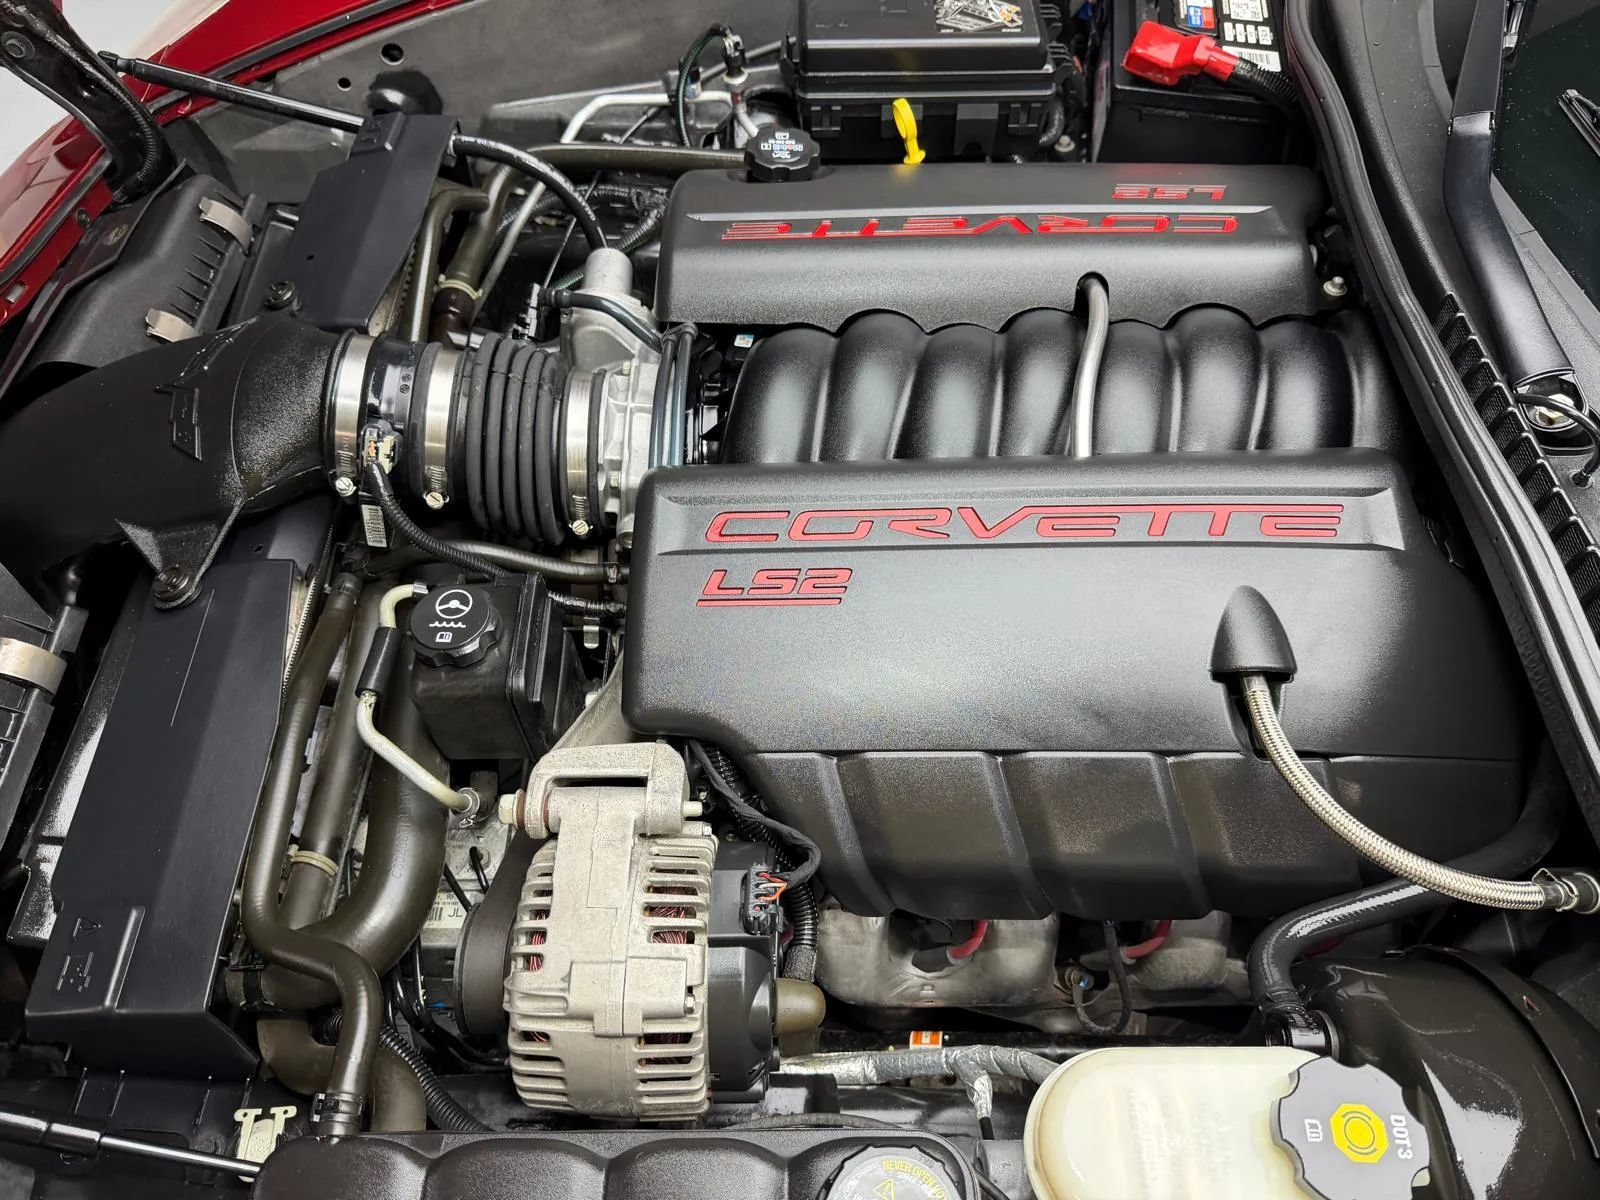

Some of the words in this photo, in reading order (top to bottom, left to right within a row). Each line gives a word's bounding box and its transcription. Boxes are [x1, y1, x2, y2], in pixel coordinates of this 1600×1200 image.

[1110, 184, 1227, 202] LS2
[722, 215, 1239, 240] CORVETTE
[704, 502, 1346, 544] CORVETTE
[701, 567, 854, 598] LS2
[1390, 1114, 1411, 1148] DOT
[882, 1160, 912, 1173] NEVER
[912, 1167, 936, 1187] OPEN
